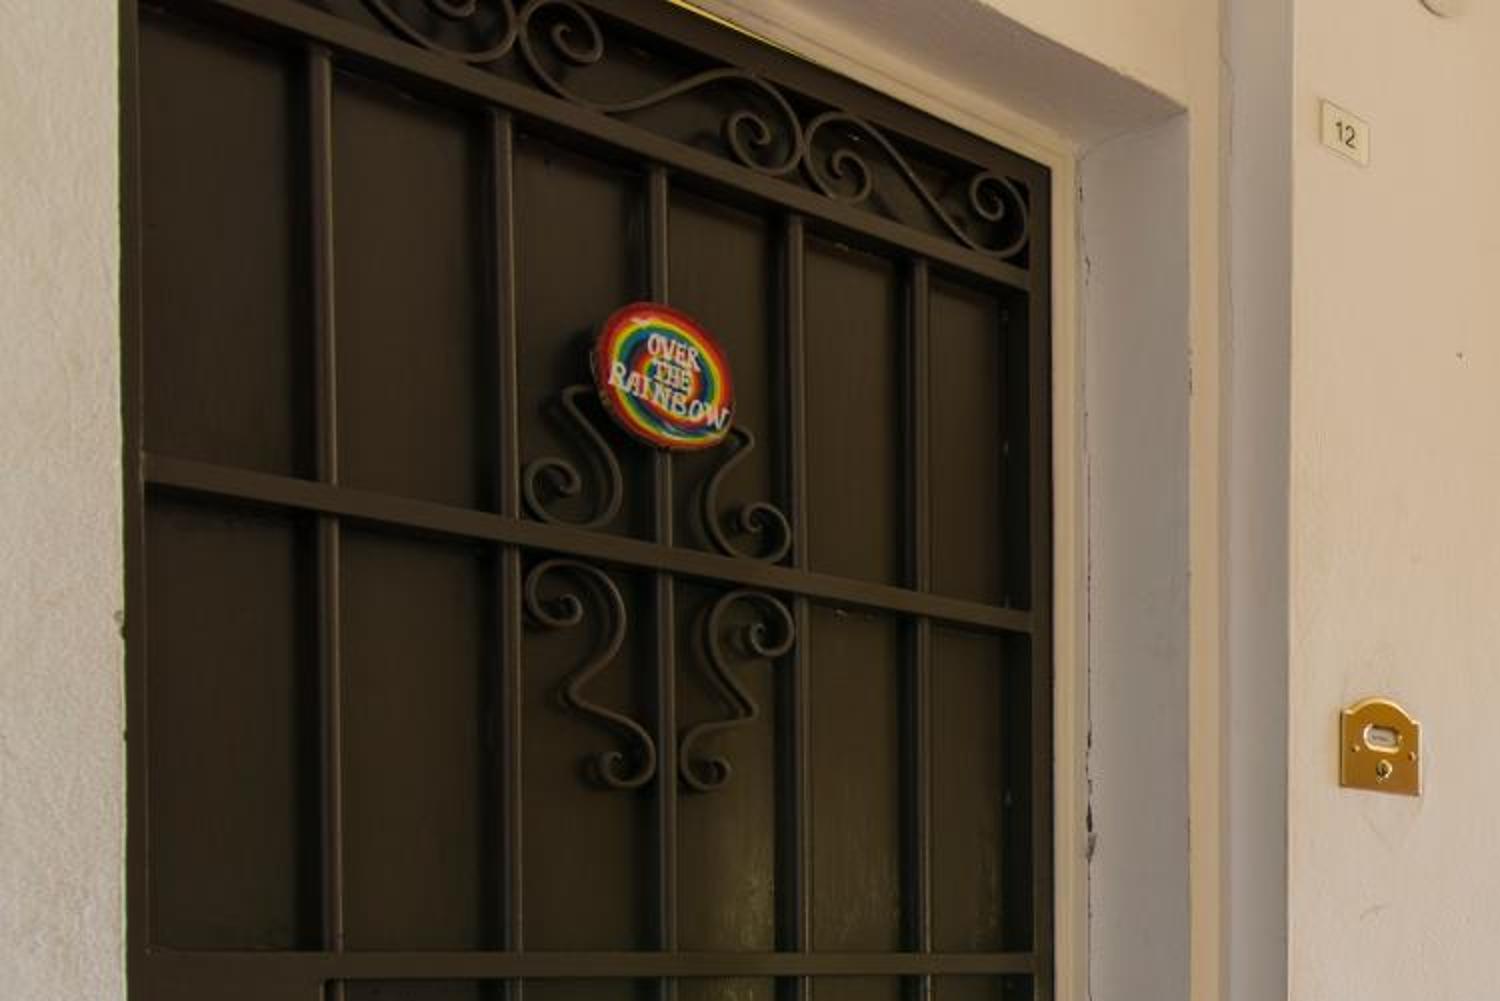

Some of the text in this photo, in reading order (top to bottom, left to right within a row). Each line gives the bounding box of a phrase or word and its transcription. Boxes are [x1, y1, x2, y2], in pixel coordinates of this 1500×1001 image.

[1335, 121, 1356, 149] 12
[647, 333, 701, 373] OVER
[652, 358, 692, 393] THE
[608, 361, 730, 430] RAINBOW
